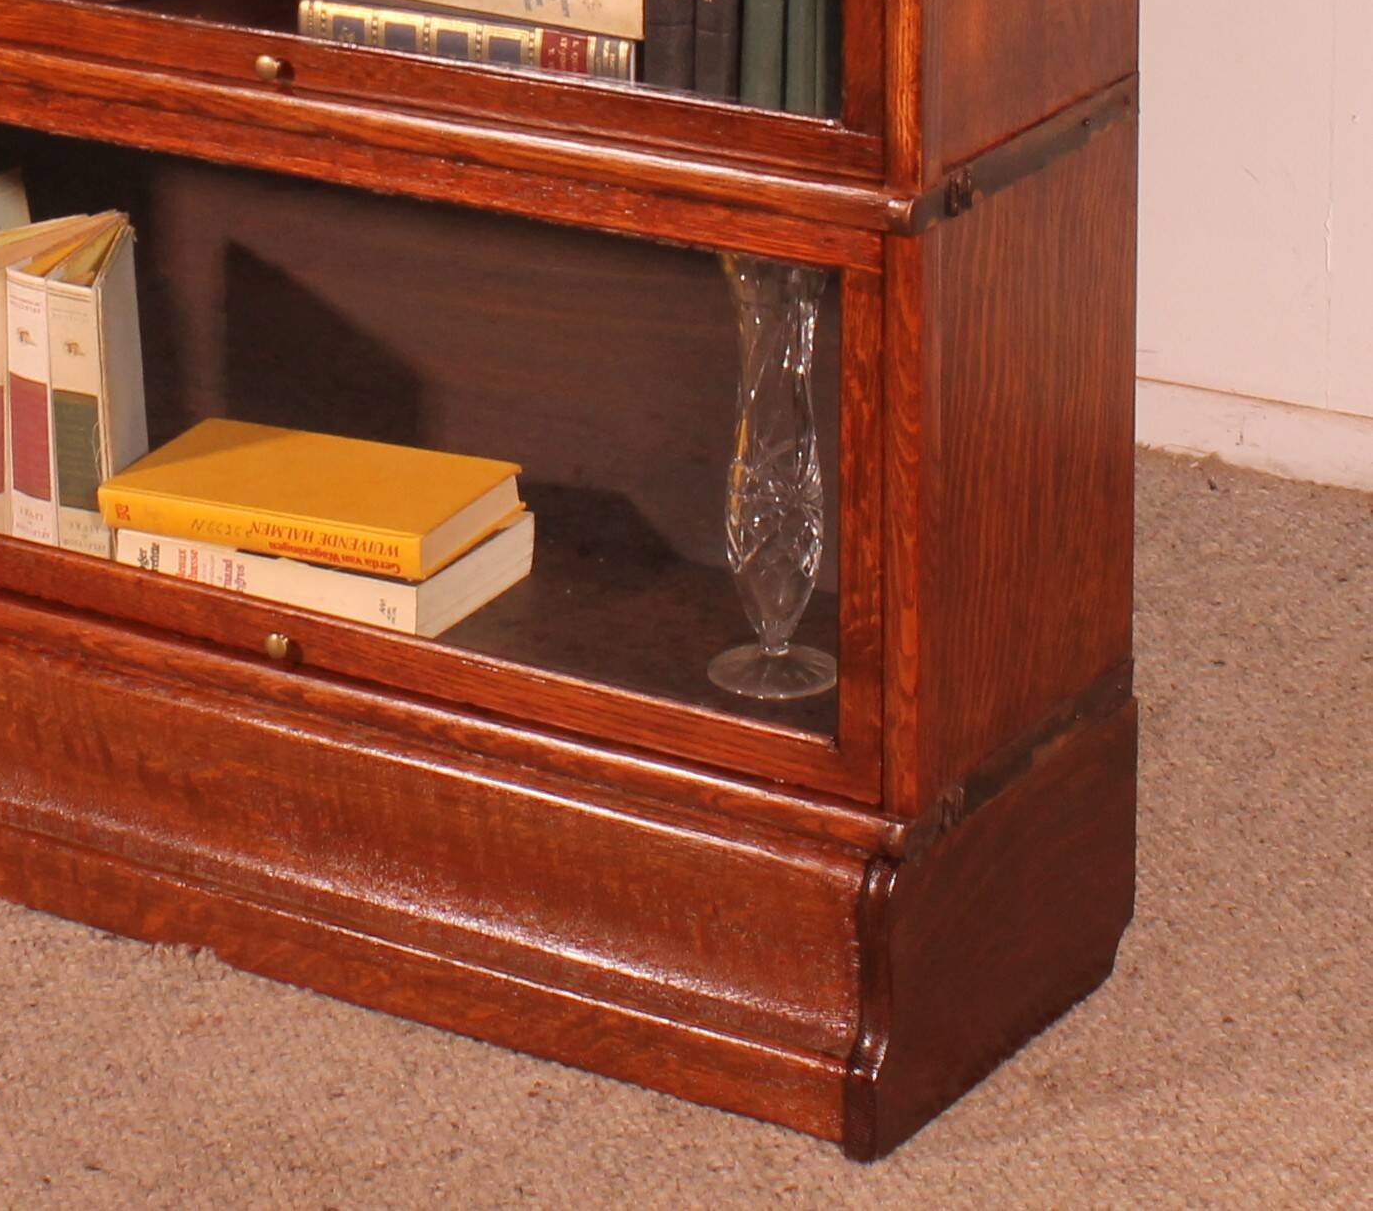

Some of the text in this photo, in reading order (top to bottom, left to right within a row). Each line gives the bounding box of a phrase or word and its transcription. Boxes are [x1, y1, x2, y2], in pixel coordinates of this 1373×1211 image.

[249, 521, 315, 544] HALMEN
[318, 531, 400, 558] WUIVENDE
[268, 541, 401, 575] Gerda van Wageningen
